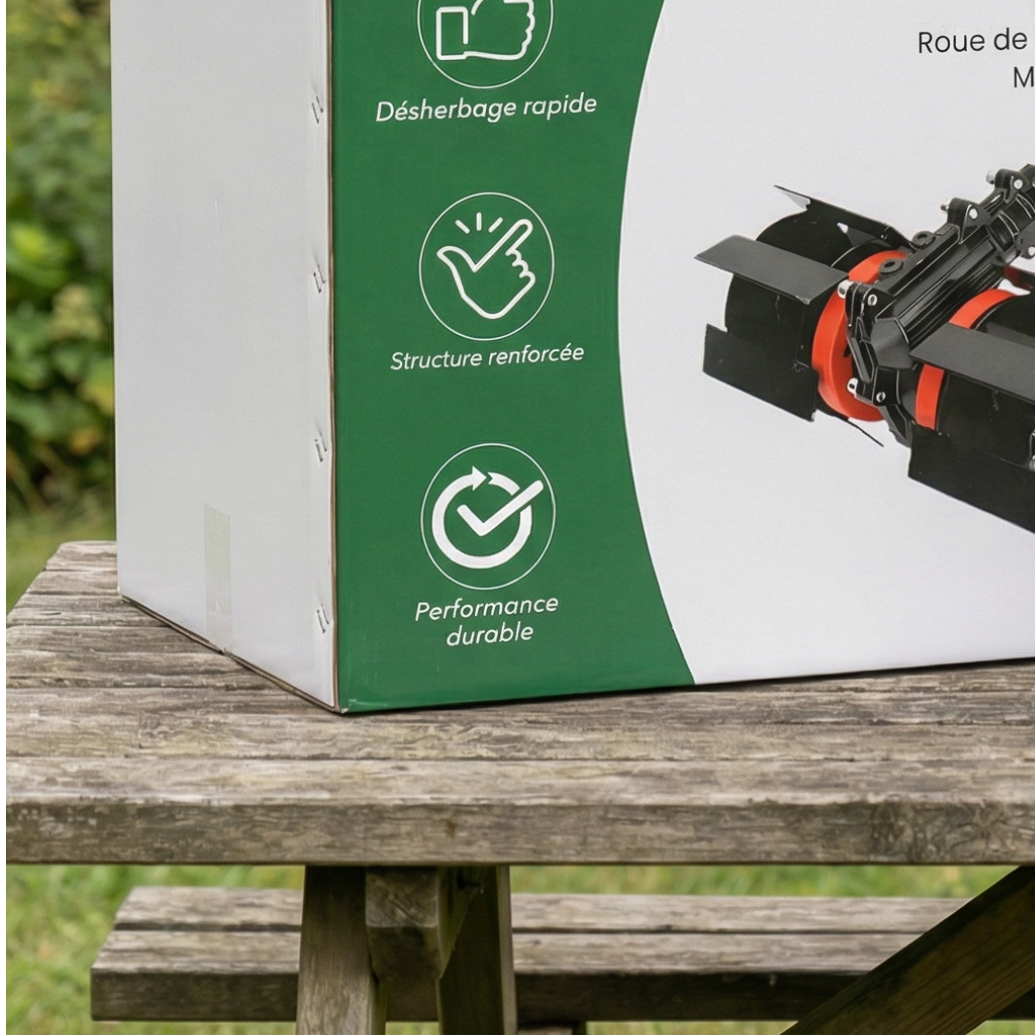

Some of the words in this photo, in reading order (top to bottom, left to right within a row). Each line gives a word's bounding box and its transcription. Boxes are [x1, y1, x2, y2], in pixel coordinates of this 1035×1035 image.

[918, 30, 985, 54] Roue
[993, 27, 1028, 52] de
[375, 97, 517, 123] Désherbage
[523, 91, 598, 121] rapide
[390, 350, 483, 371] Structure
[488, 343, 585, 366] renforcée
[414, 597, 559, 622] Performance
[446, 621, 534, 647] durable
